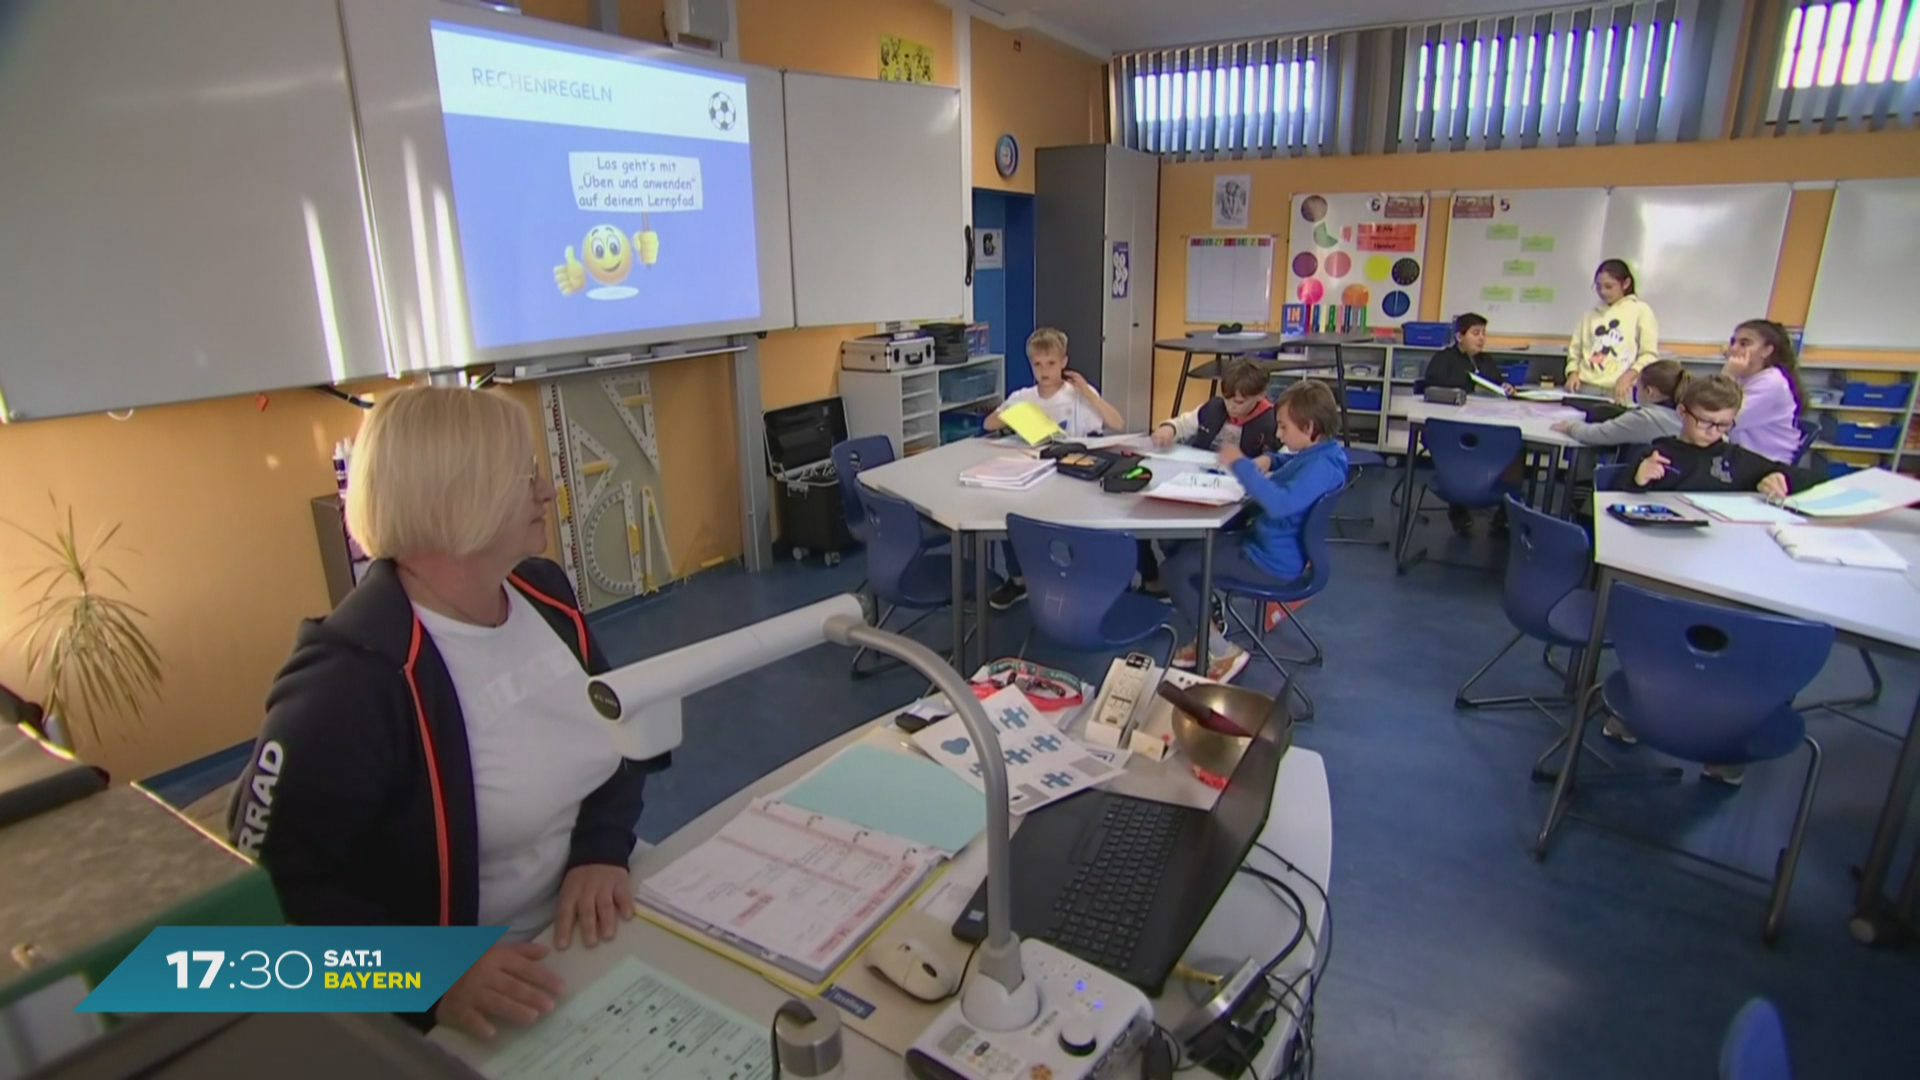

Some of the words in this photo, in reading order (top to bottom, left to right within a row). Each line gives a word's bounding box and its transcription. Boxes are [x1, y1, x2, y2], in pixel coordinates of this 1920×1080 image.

[472, 67, 613, 102] RECHENREGELN
[597, 156, 617, 171] Los
[622, 158, 655, 174] geht's
[660, 162, 676, 173] mit
[618, 177, 638, 190] und
[579, 194, 598, 208] auf
[604, 194, 643, 208] deinem
[647, 194, 695, 209] Lernpfad
